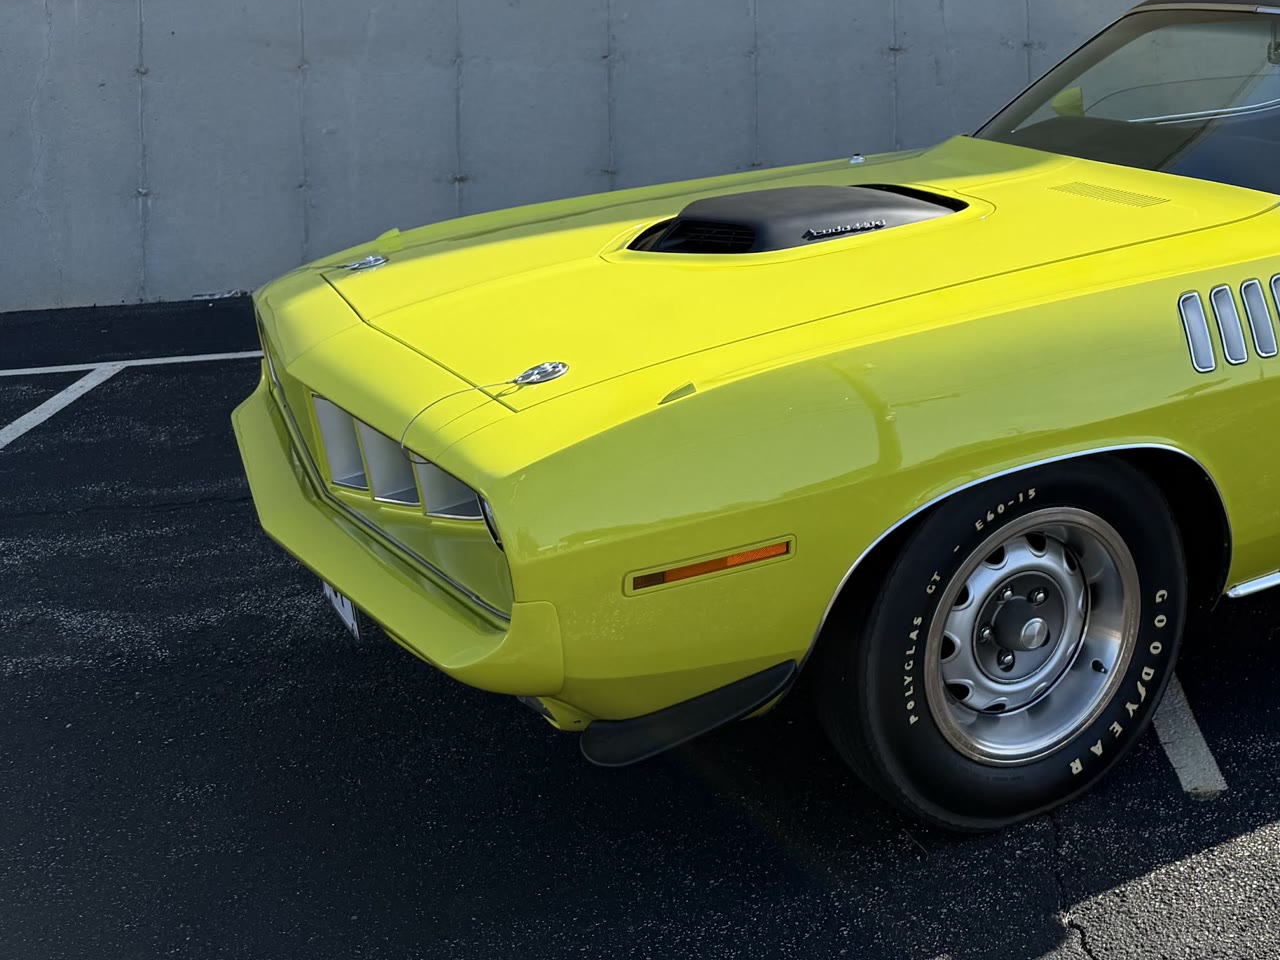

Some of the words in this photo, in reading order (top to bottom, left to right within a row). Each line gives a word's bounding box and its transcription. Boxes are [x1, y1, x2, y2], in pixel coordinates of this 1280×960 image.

[904, 615, 923, 726] POLYGLAS
[926, 570, 942, 595] GT
[1069, 589, 1169, 776] GOODYEAR
